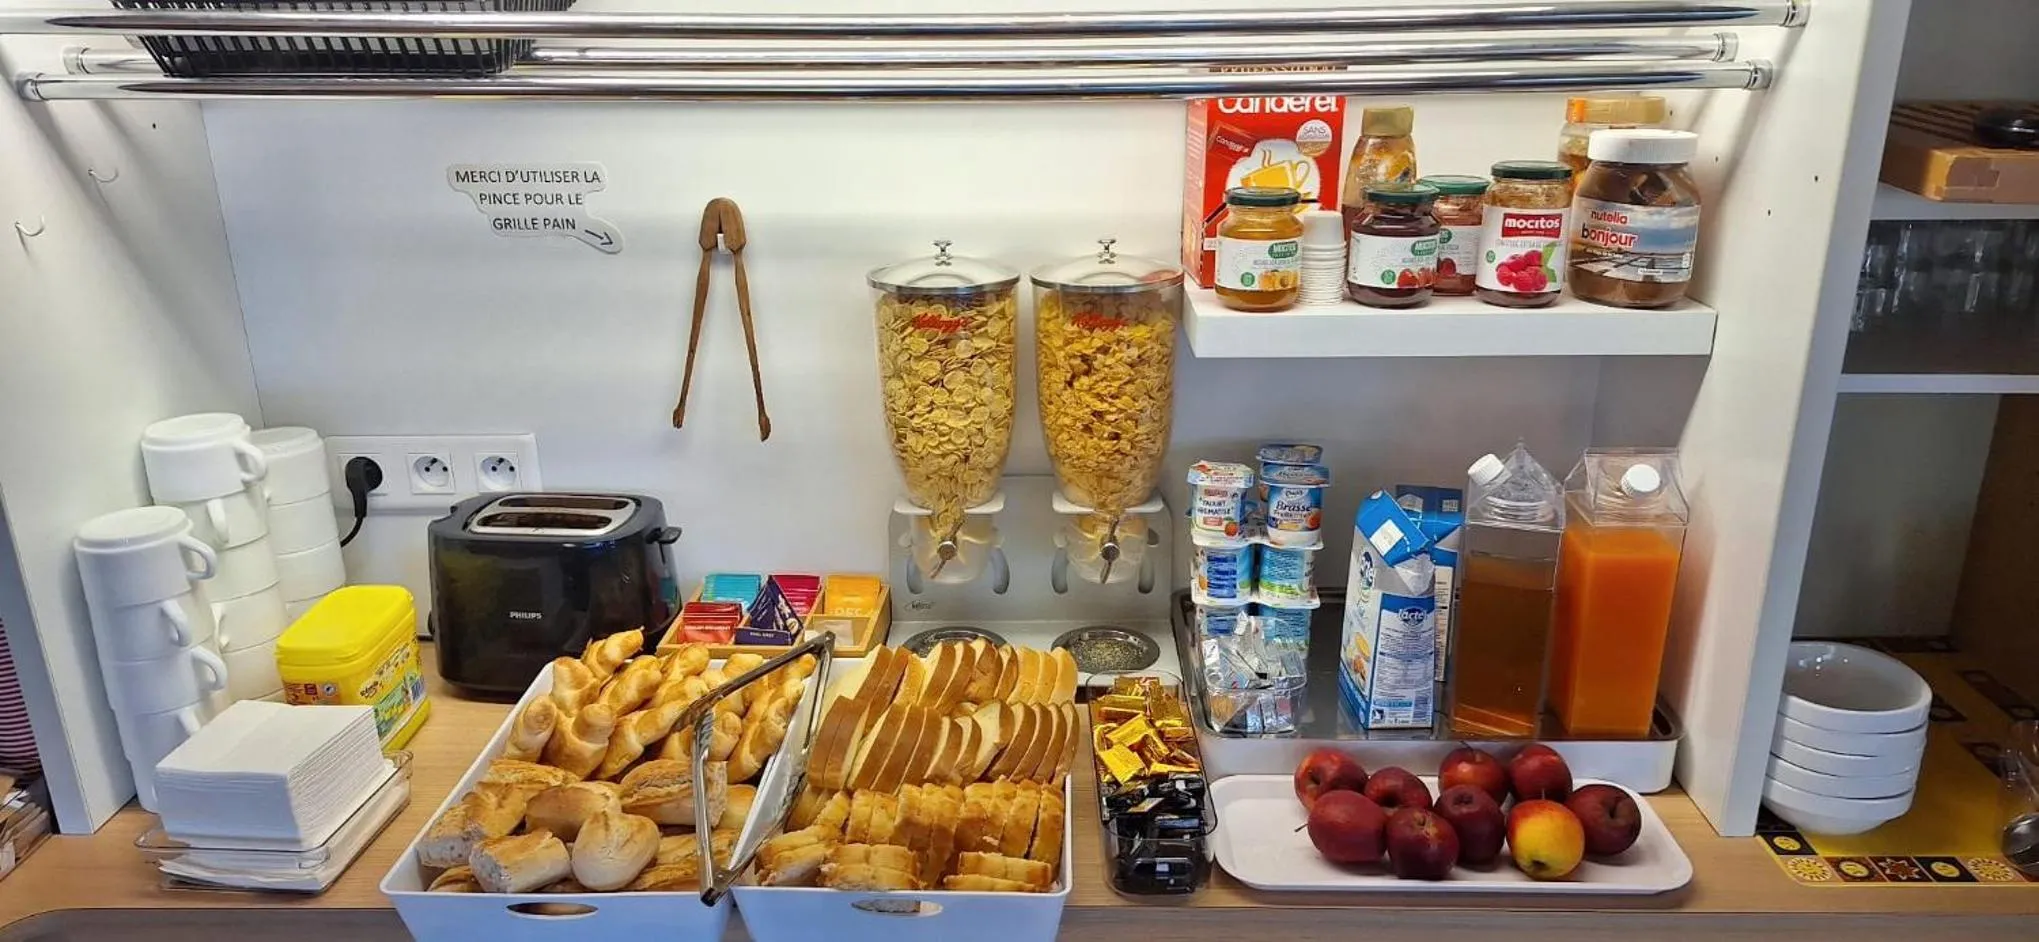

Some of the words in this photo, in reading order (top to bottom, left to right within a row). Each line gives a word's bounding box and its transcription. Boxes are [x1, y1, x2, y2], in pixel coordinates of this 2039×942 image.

[454, 170, 501, 183] MERCI
[505, 170, 580, 183] D'UTILISER
[584, 170, 601, 183] LA
[479, 193, 521, 205] PINCE
[524, 193, 564, 205] POUR
[567, 193, 583, 205] LE
[1504, 216, 1560, 229] mocitos
[1591, 210, 1628, 224] nutella
[492, 218, 539, 230] GRILLE
[543, 218, 576, 230] PAIN
[1581, 223, 1636, 247] bonjour
[510, 611, 542, 619] PHILIPS
